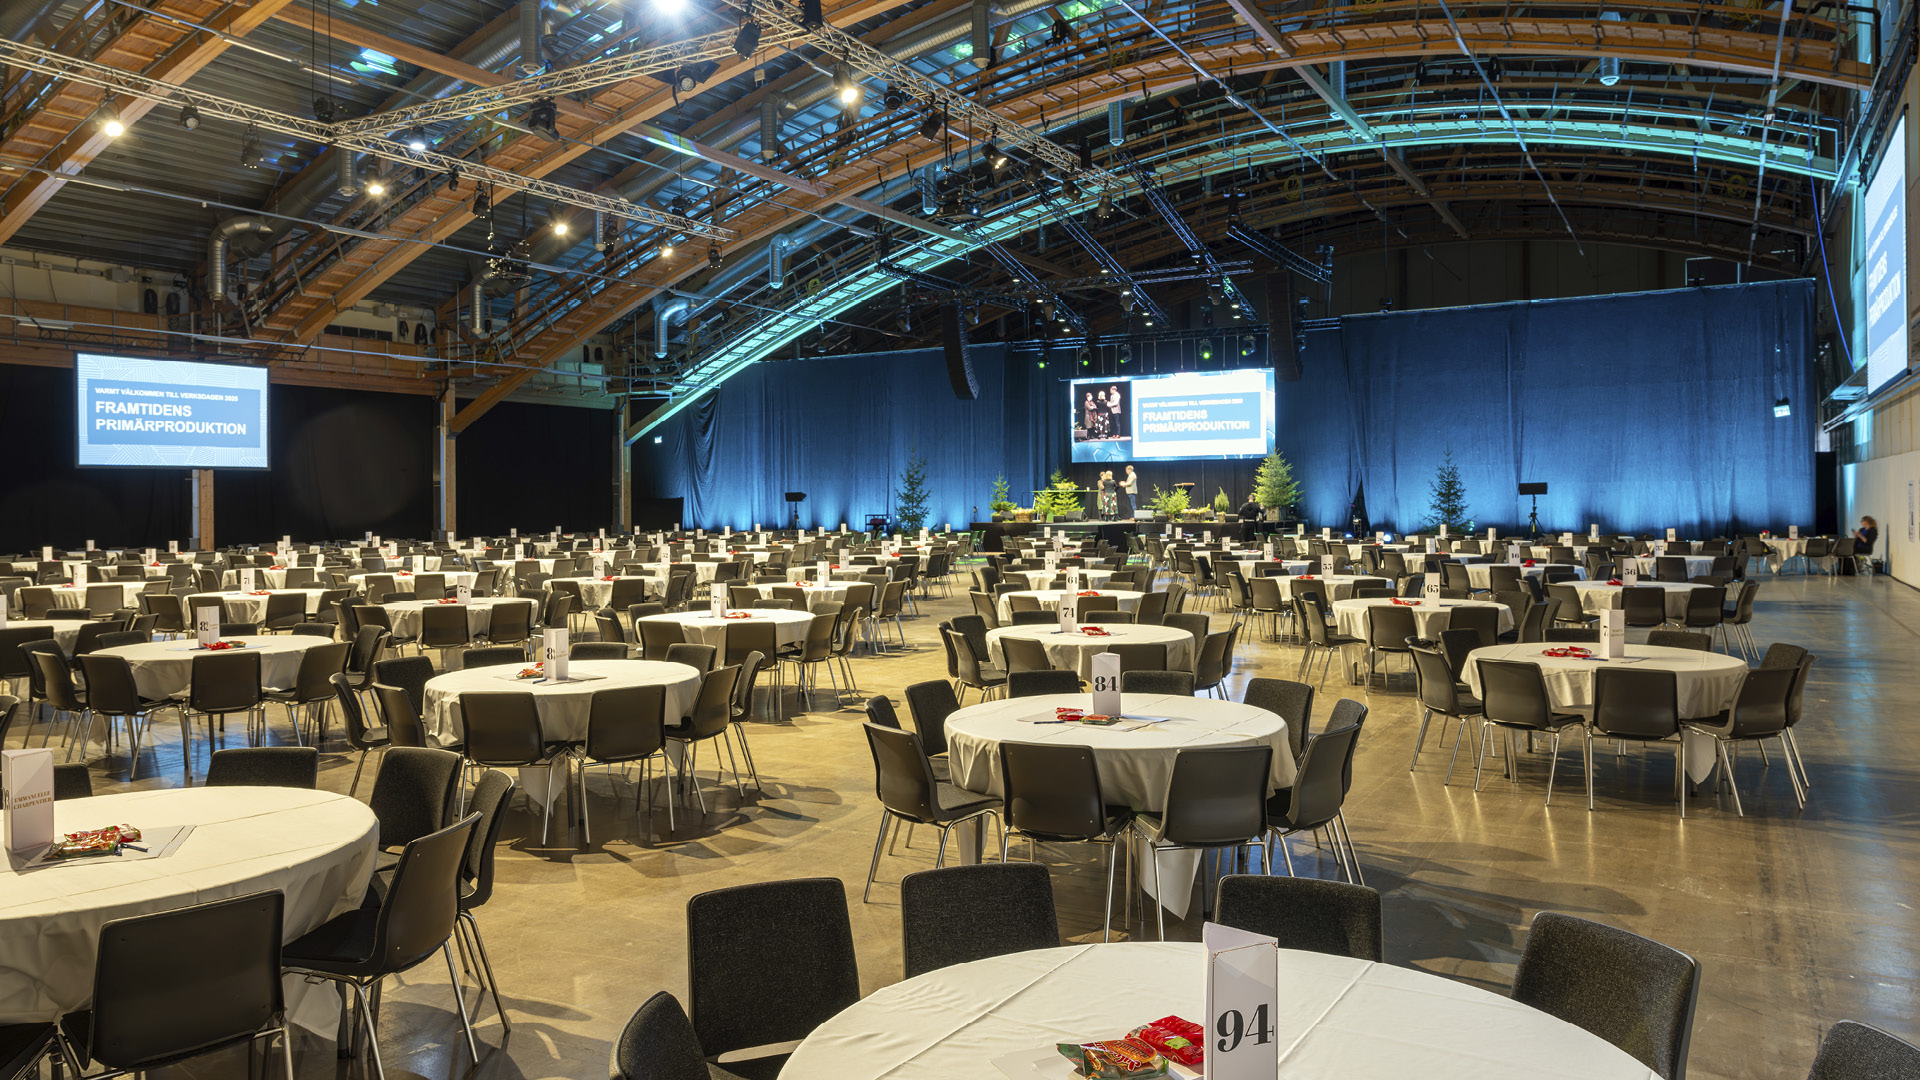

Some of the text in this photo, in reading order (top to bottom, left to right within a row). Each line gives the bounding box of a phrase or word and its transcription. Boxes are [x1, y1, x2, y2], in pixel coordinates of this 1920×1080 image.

[95, 387, 120, 395] VARMT
[121, 388, 165, 397] VÄLKOMMEN
[180, 392, 224, 400] VERKSDAGEN
[95, 401, 192, 417] FRAMTIDENS
[1142, 409, 1208, 421] FRAMTIDENS
[95, 418, 247, 435] PRIMÄRPRODUKTION
[1142, 421, 1250, 433] PRIMÄRPRODUKTION
[1426, 584, 1439, 593] 65
[1095, 675, 1118, 692] 84
[13, 797, 52, 810] CHARPENTIER
[14, 791, 50, 803] EMMANUELLE
[1216, 1003, 1275, 1053] 94
